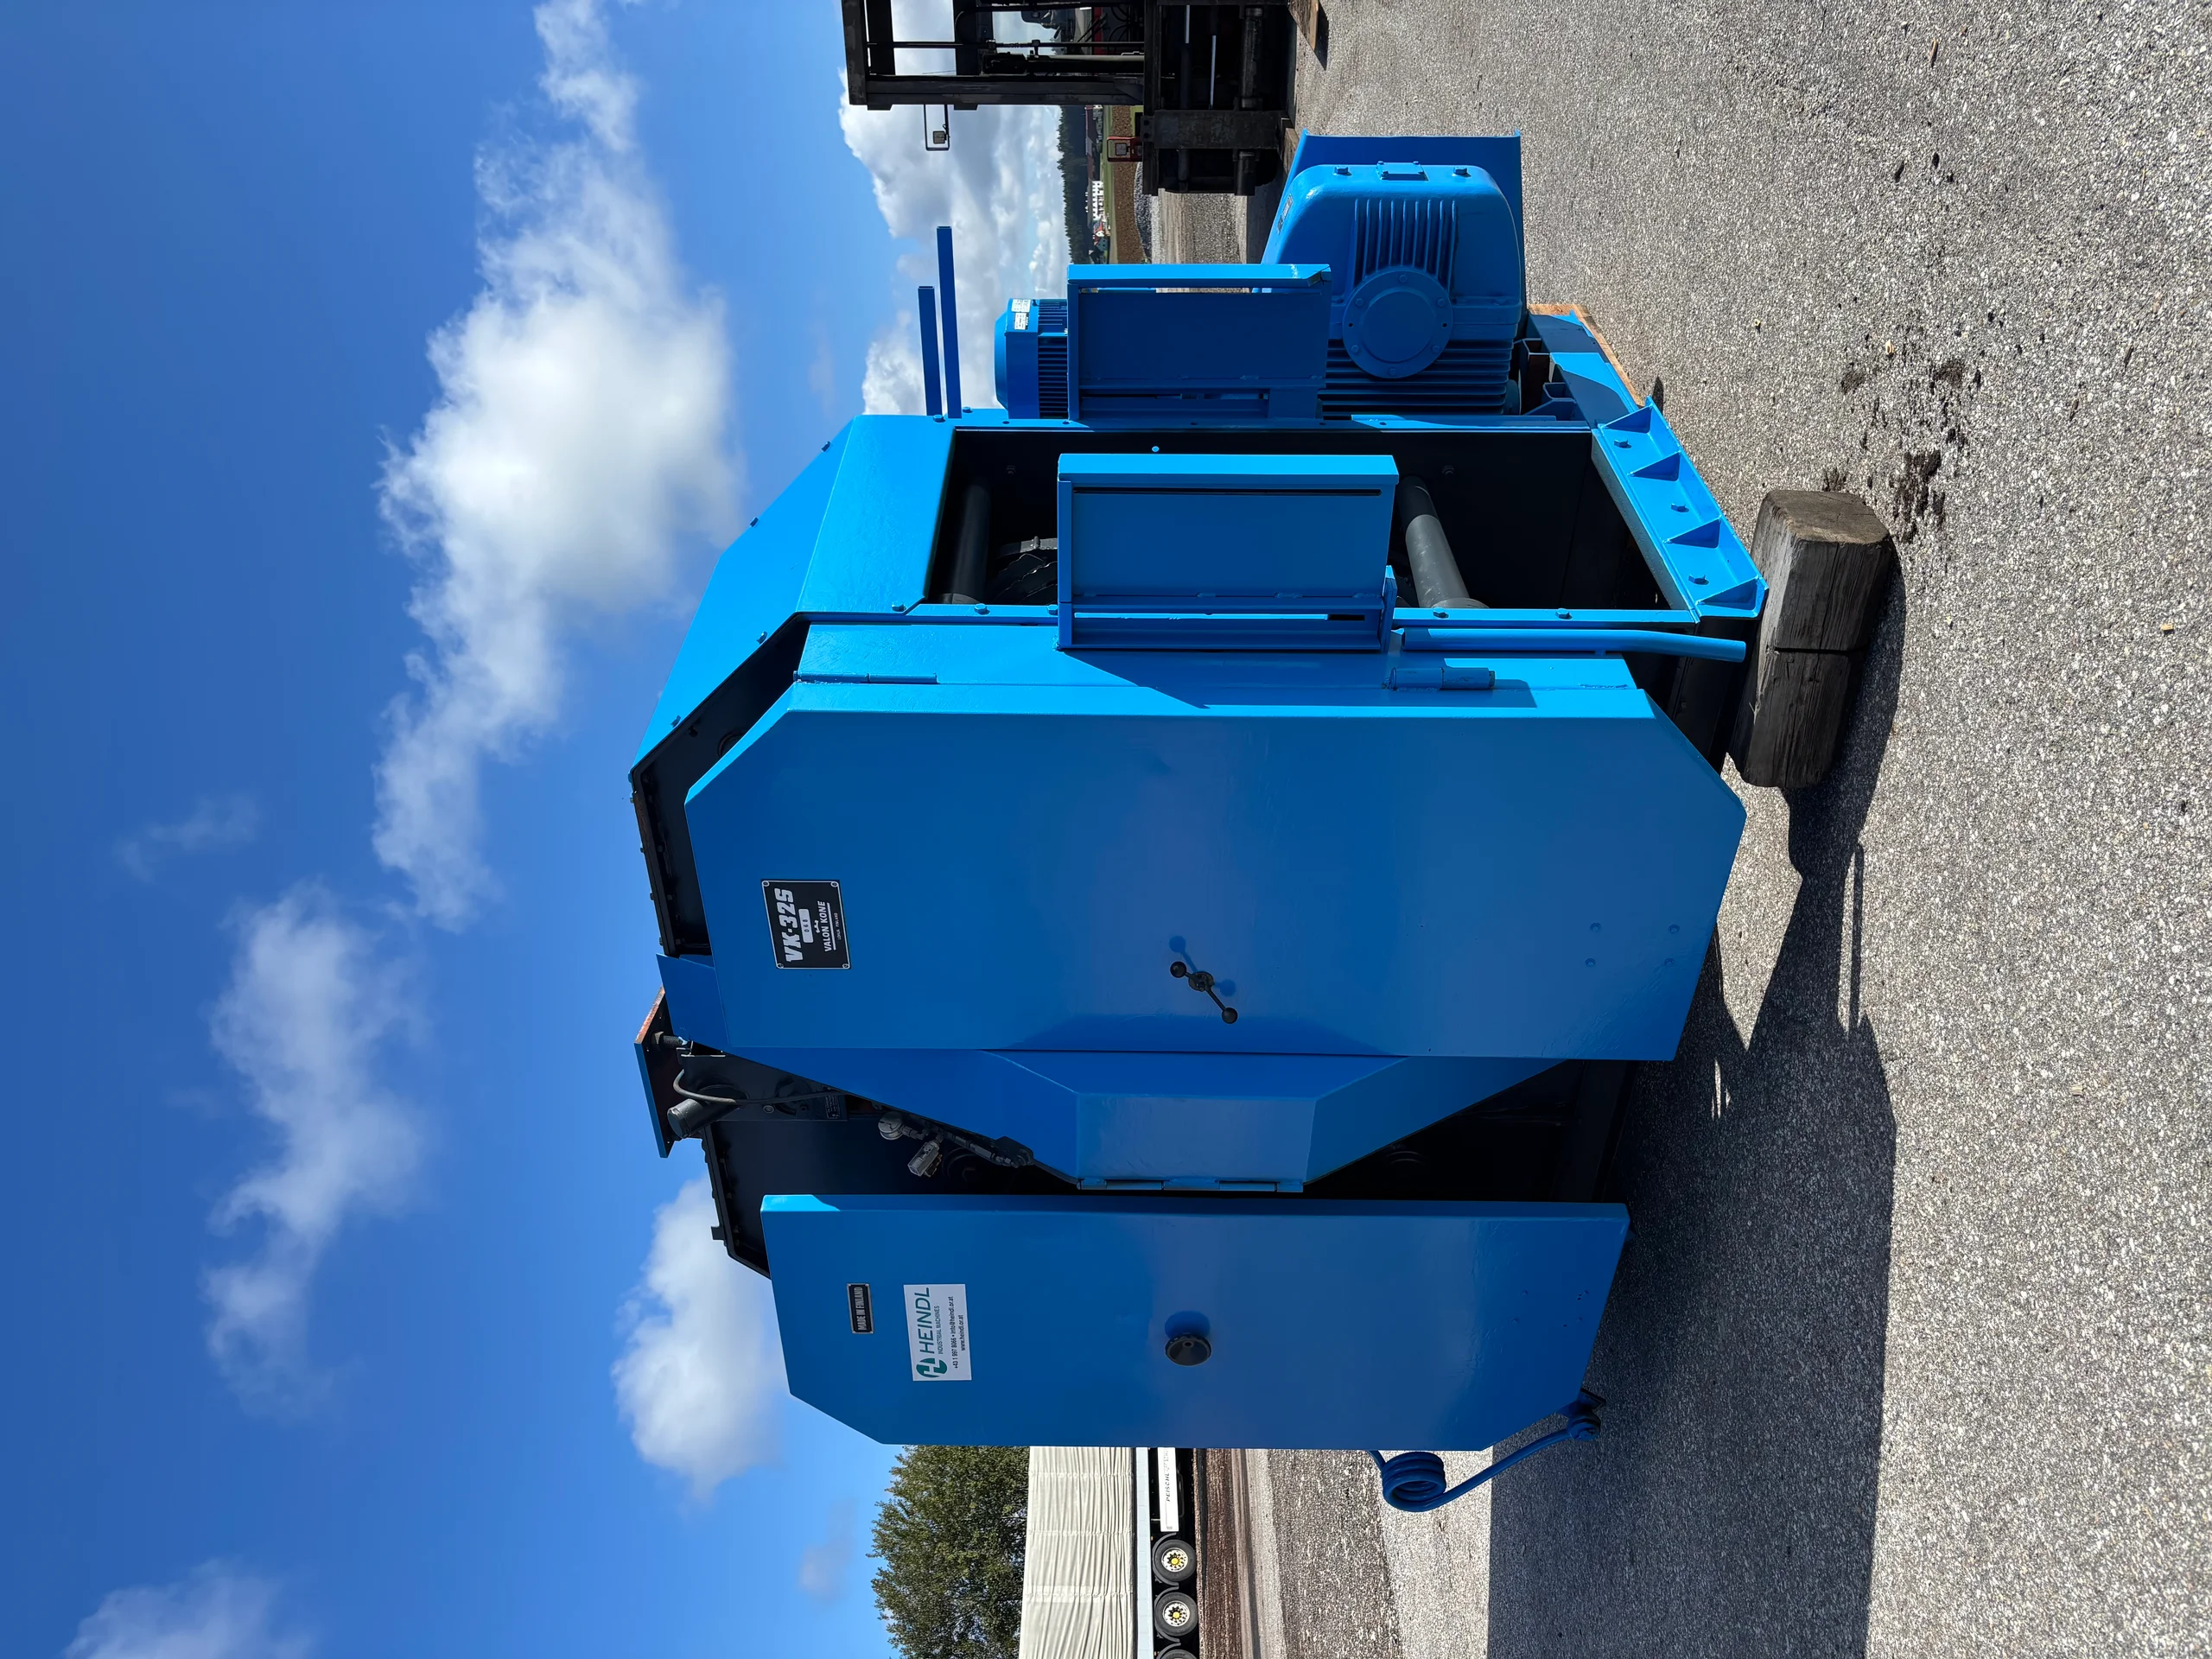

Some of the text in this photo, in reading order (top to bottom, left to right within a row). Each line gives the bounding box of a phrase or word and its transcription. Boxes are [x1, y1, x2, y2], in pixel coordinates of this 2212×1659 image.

[817, 901, 831, 951] VALON KONE
[854, 1287, 864, 1308] FINLAND
[856, 1316, 867, 1331] MADE
[914, 1287, 935, 1354] HEINDL
